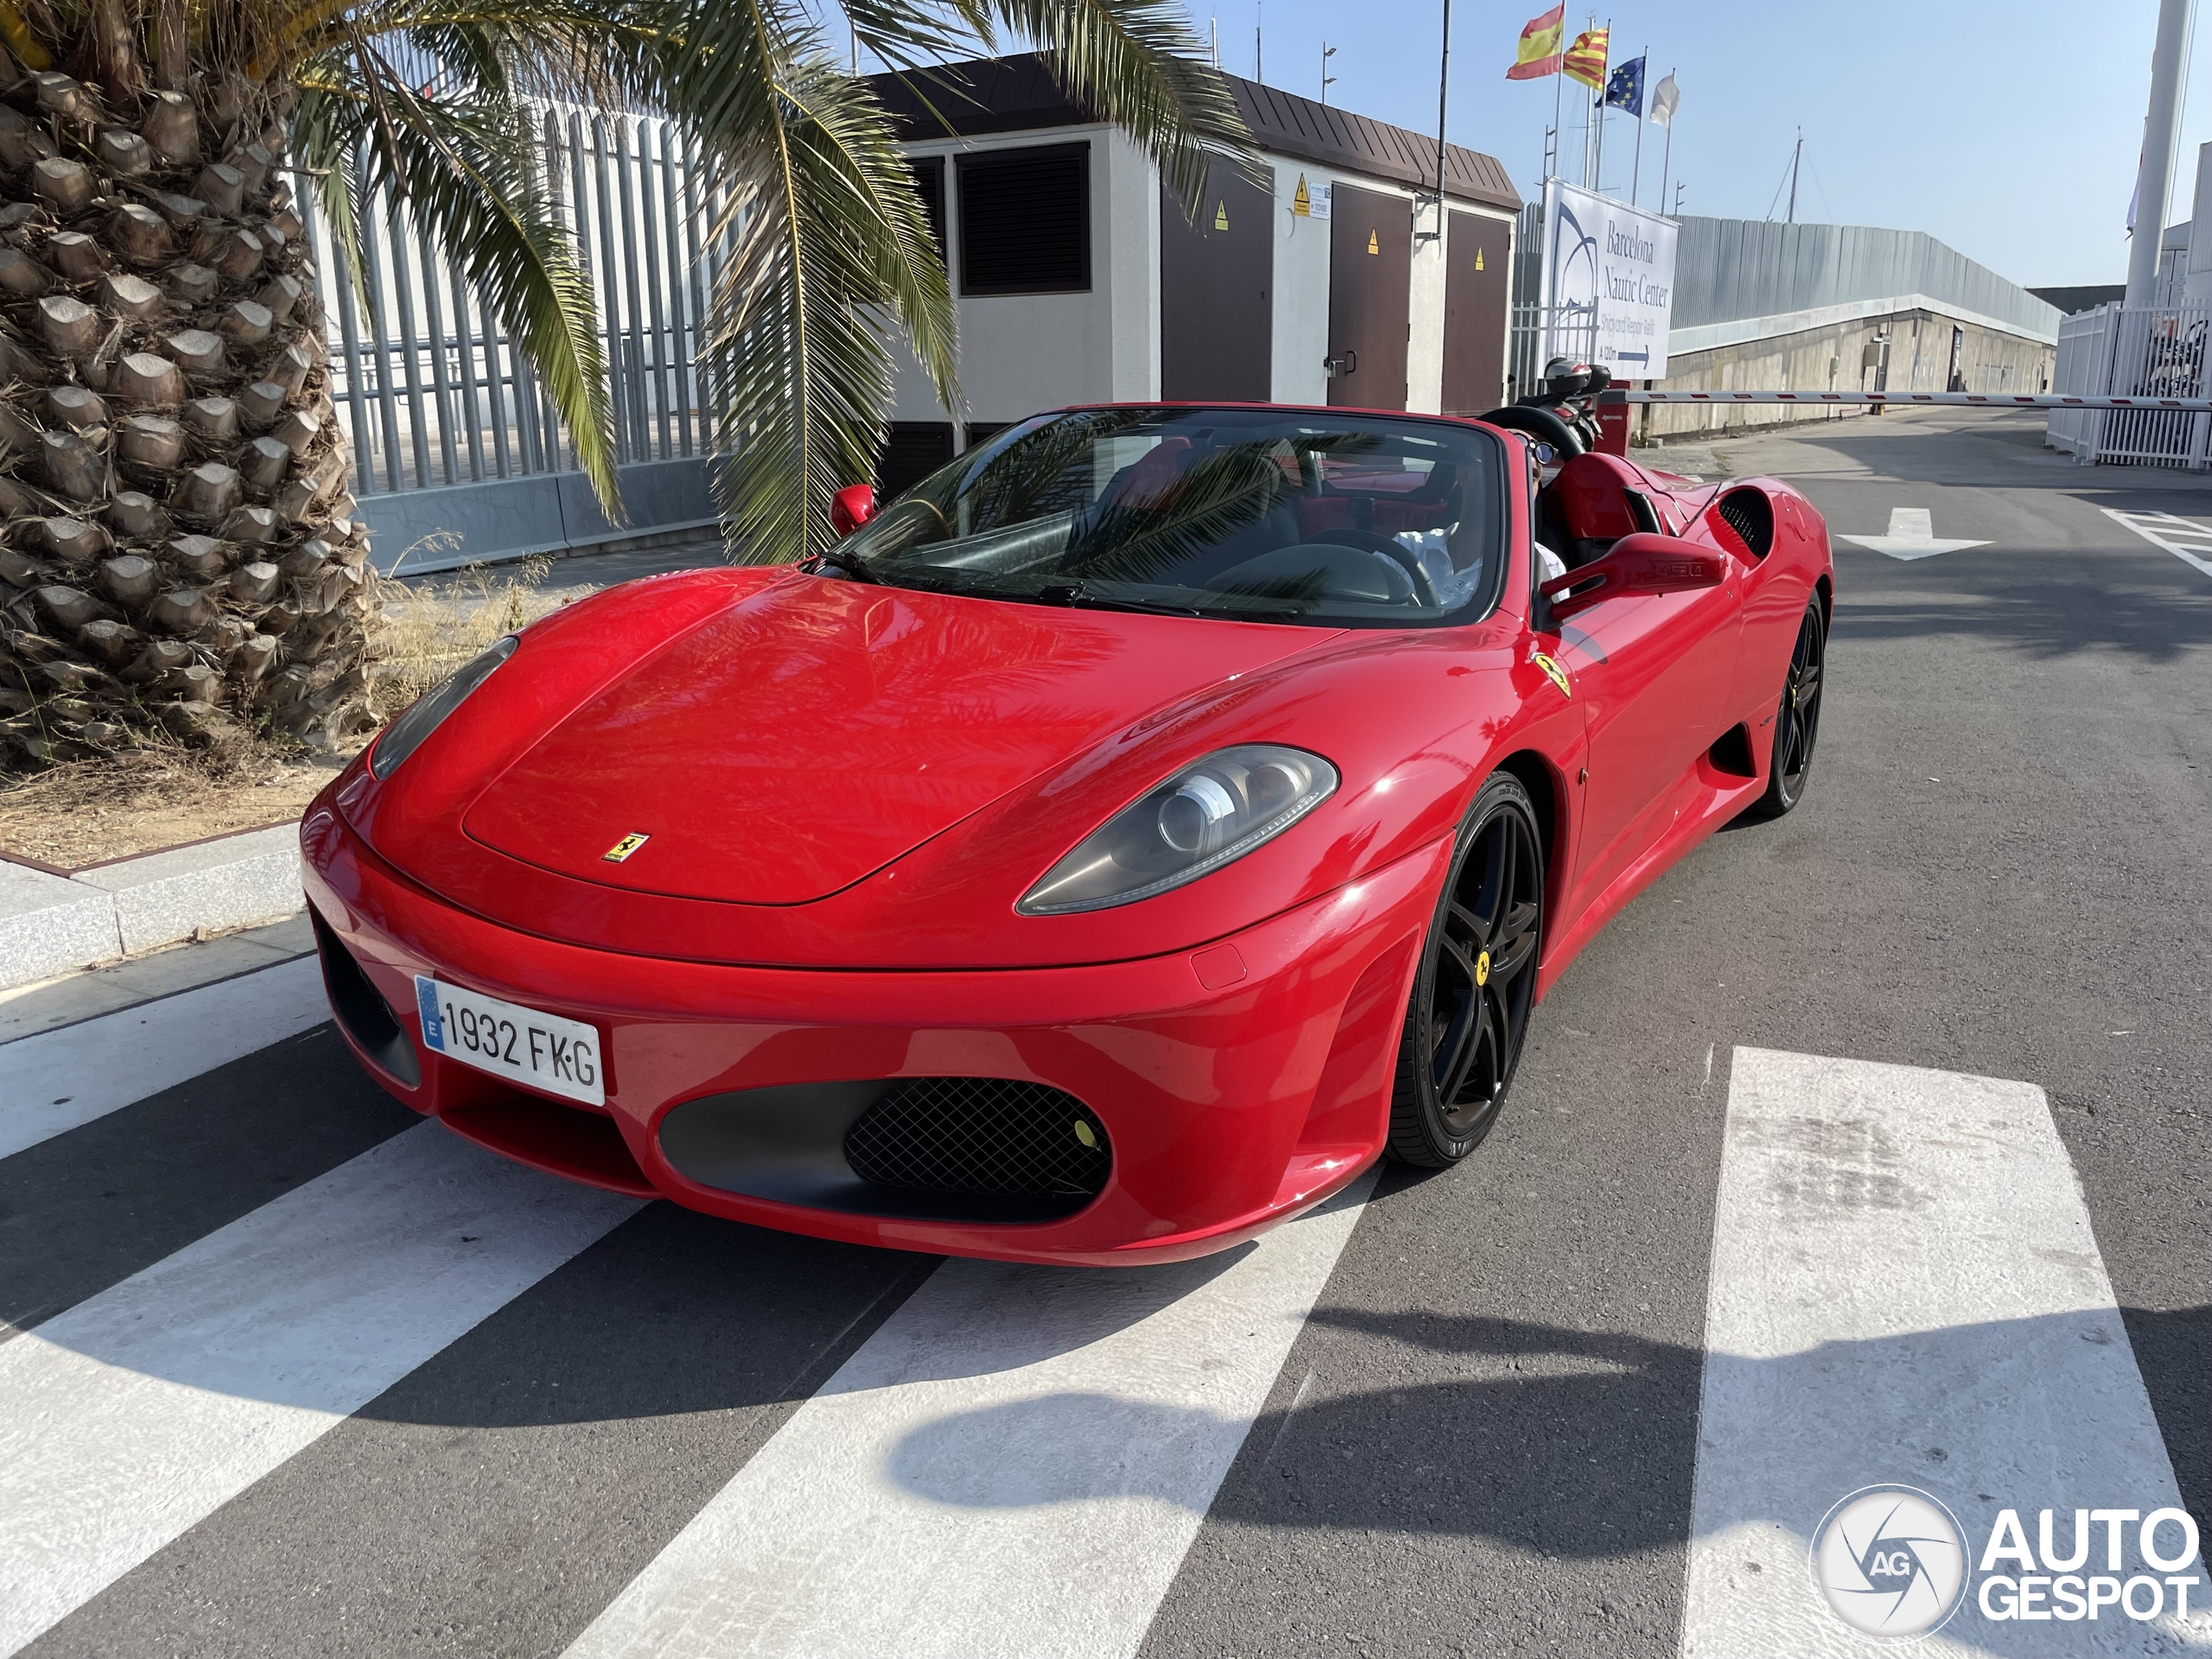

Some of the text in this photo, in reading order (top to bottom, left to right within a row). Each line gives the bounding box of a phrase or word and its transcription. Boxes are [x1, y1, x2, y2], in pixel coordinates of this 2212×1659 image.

[1606, 220, 1654, 264] Barcelona
[1604, 265, 1669, 308] Nautic Center
[1601, 314, 1655, 340] Shipyard Repair Refit
[428, 1020, 438, 1037] E
[446, 1002, 595, 1086] 1932 FKG
